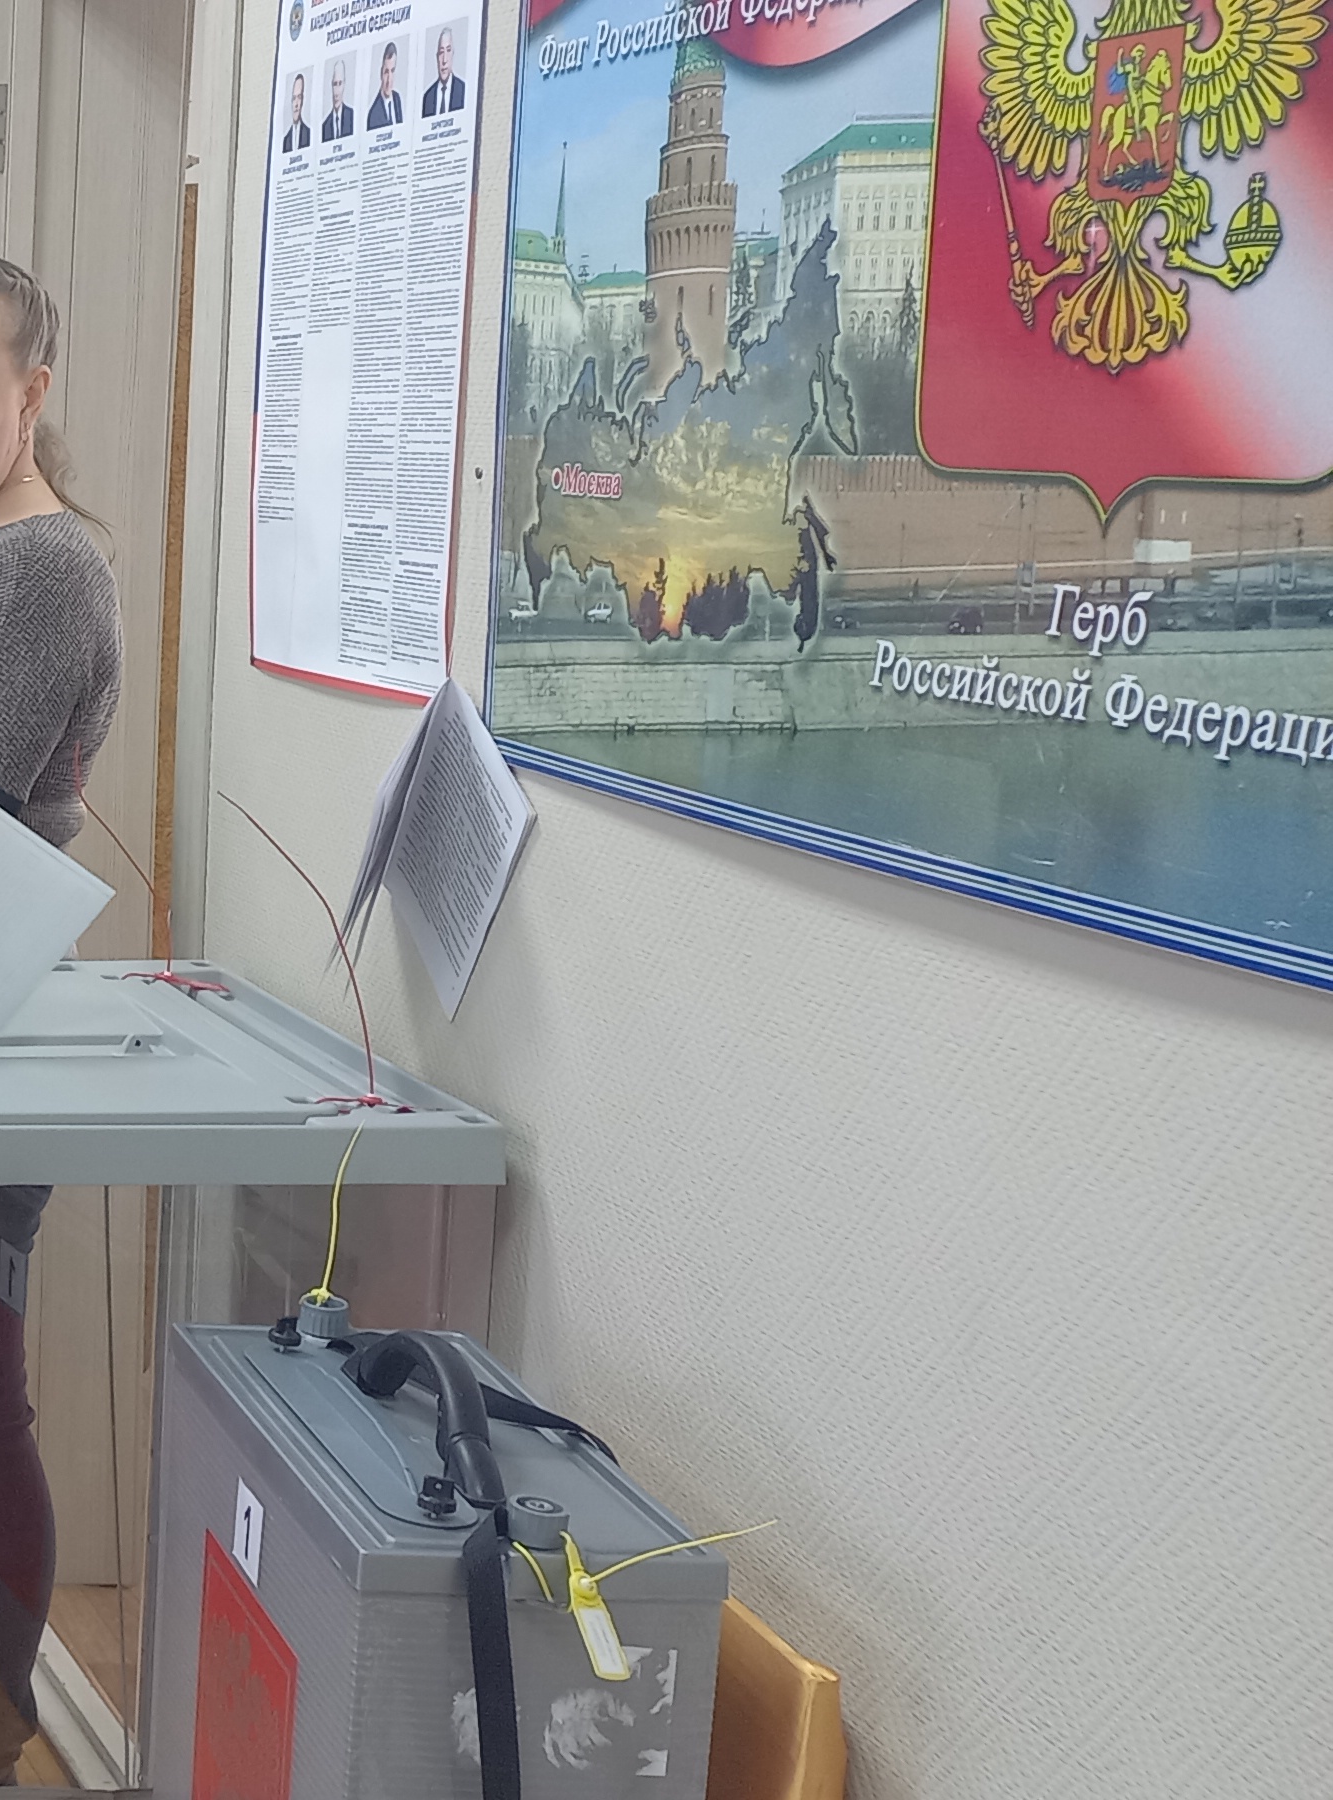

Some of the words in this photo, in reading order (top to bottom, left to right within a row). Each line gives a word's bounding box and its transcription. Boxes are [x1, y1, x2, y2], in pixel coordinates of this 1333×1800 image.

[368, 4, 412, 33] ФЕДЕРАЦИИ
[538, 33, 590, 75] Флаг
[592, 0, 732, 63] Российской
[561, 463, 622, 498] Москва
[1046, 584, 1155, 657] Герб
[870, 639, 1093, 721] Российской
[1105, 674, 1333, 766] Федераци
[243, 1505, 252, 1561] 1
